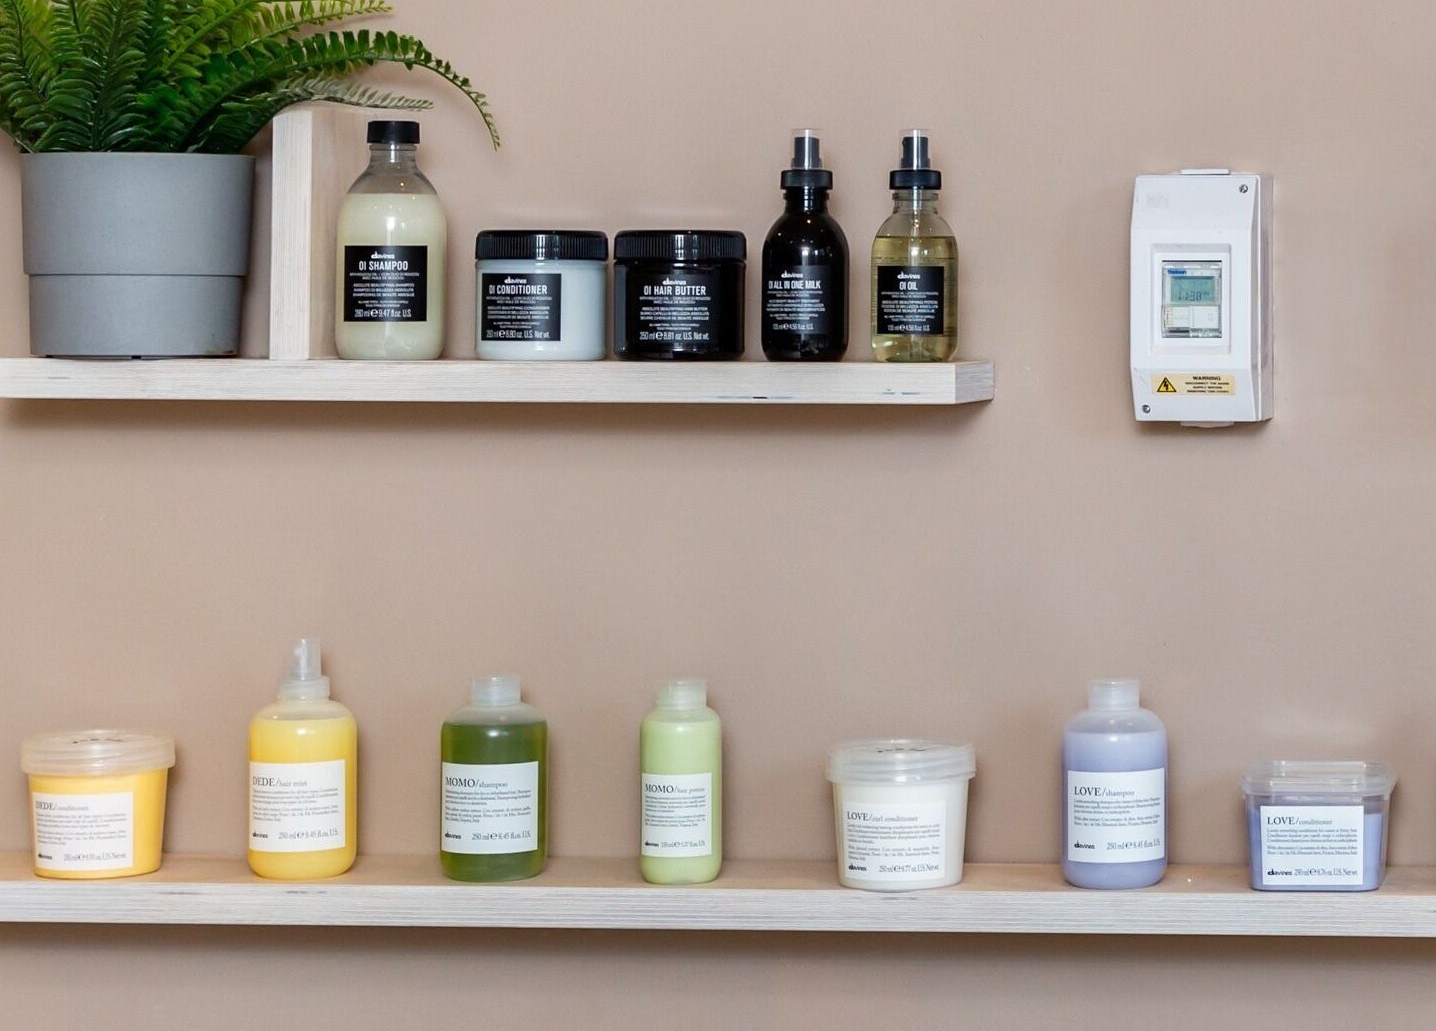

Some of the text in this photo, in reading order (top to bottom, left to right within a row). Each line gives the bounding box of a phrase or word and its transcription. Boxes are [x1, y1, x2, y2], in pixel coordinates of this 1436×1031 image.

[369, 260, 409, 271] SHAMPOO
[791, 280, 804, 289] ONE
[805, 280, 821, 289] MILK
[496, 285, 548, 295] CONDITIONER
[654, 286, 673, 296] HAIR
[675, 285, 707, 296] BUTTER
